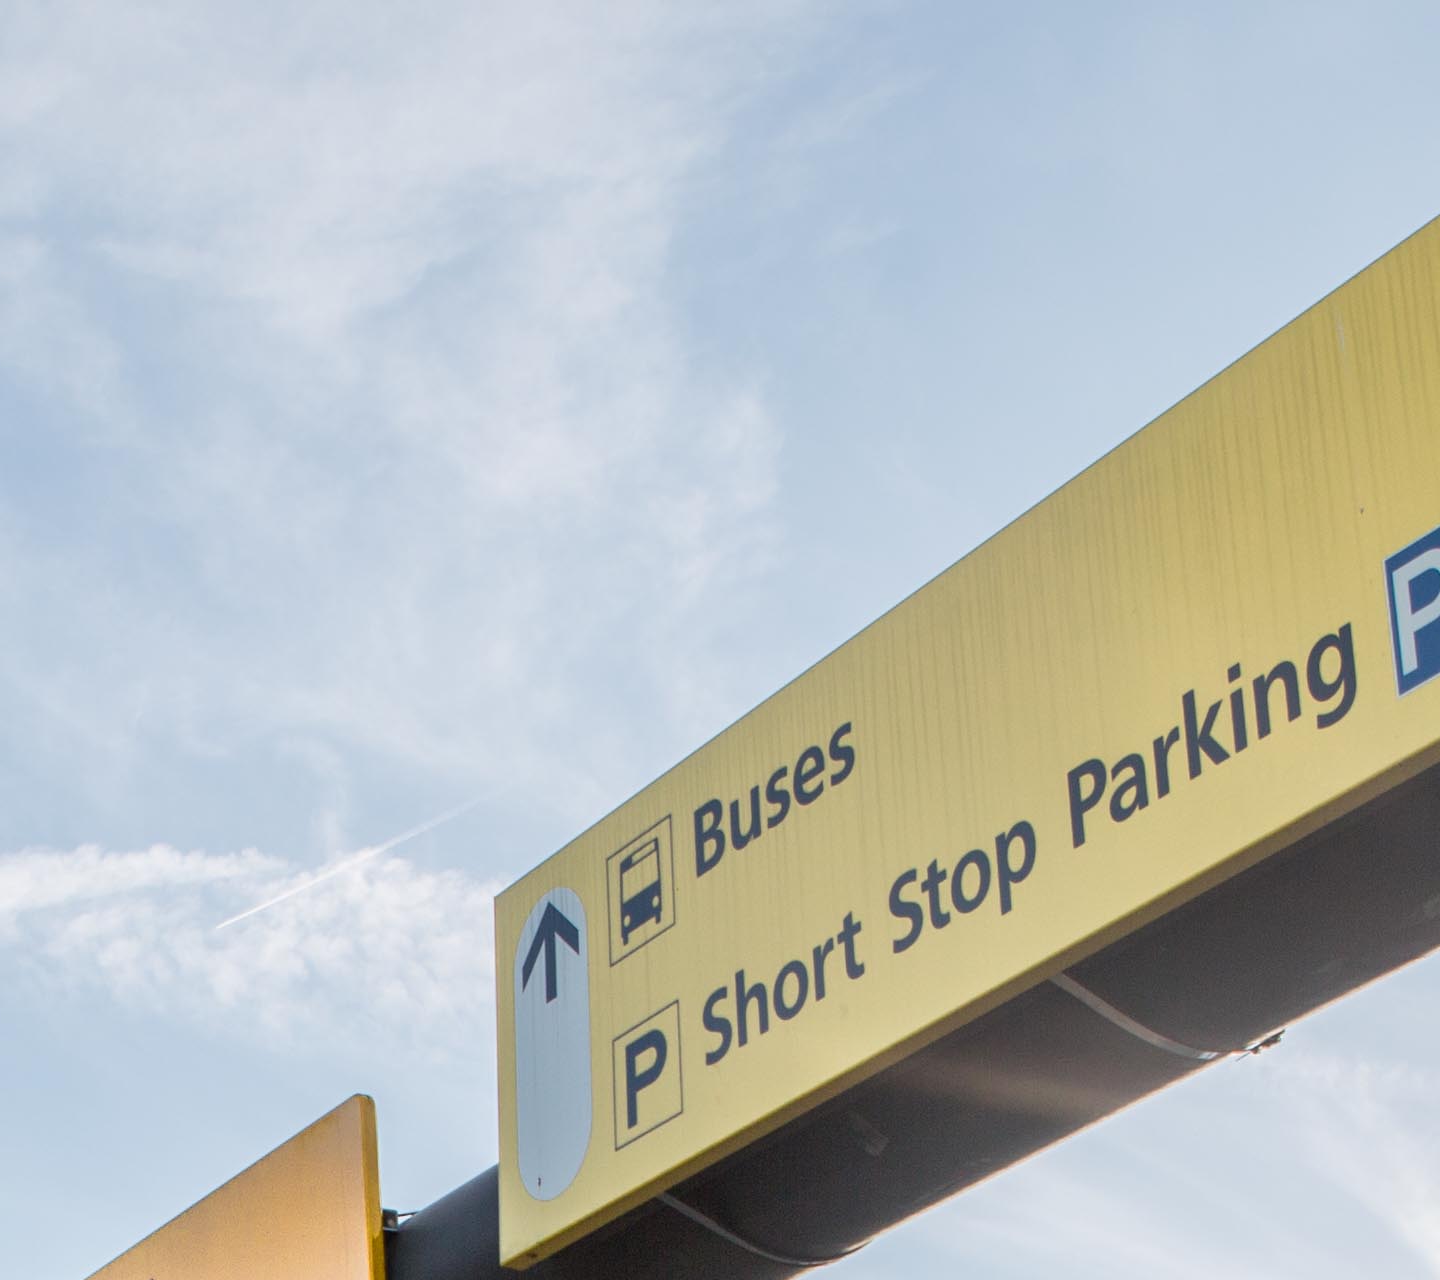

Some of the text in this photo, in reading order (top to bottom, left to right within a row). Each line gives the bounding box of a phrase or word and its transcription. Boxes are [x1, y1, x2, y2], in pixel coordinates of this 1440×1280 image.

[693, 721, 855, 877] Buses
[703, 914, 865, 1066] Short
[890, 817, 1037, 953] Stop
[1066, 620, 1358, 850] Parking
